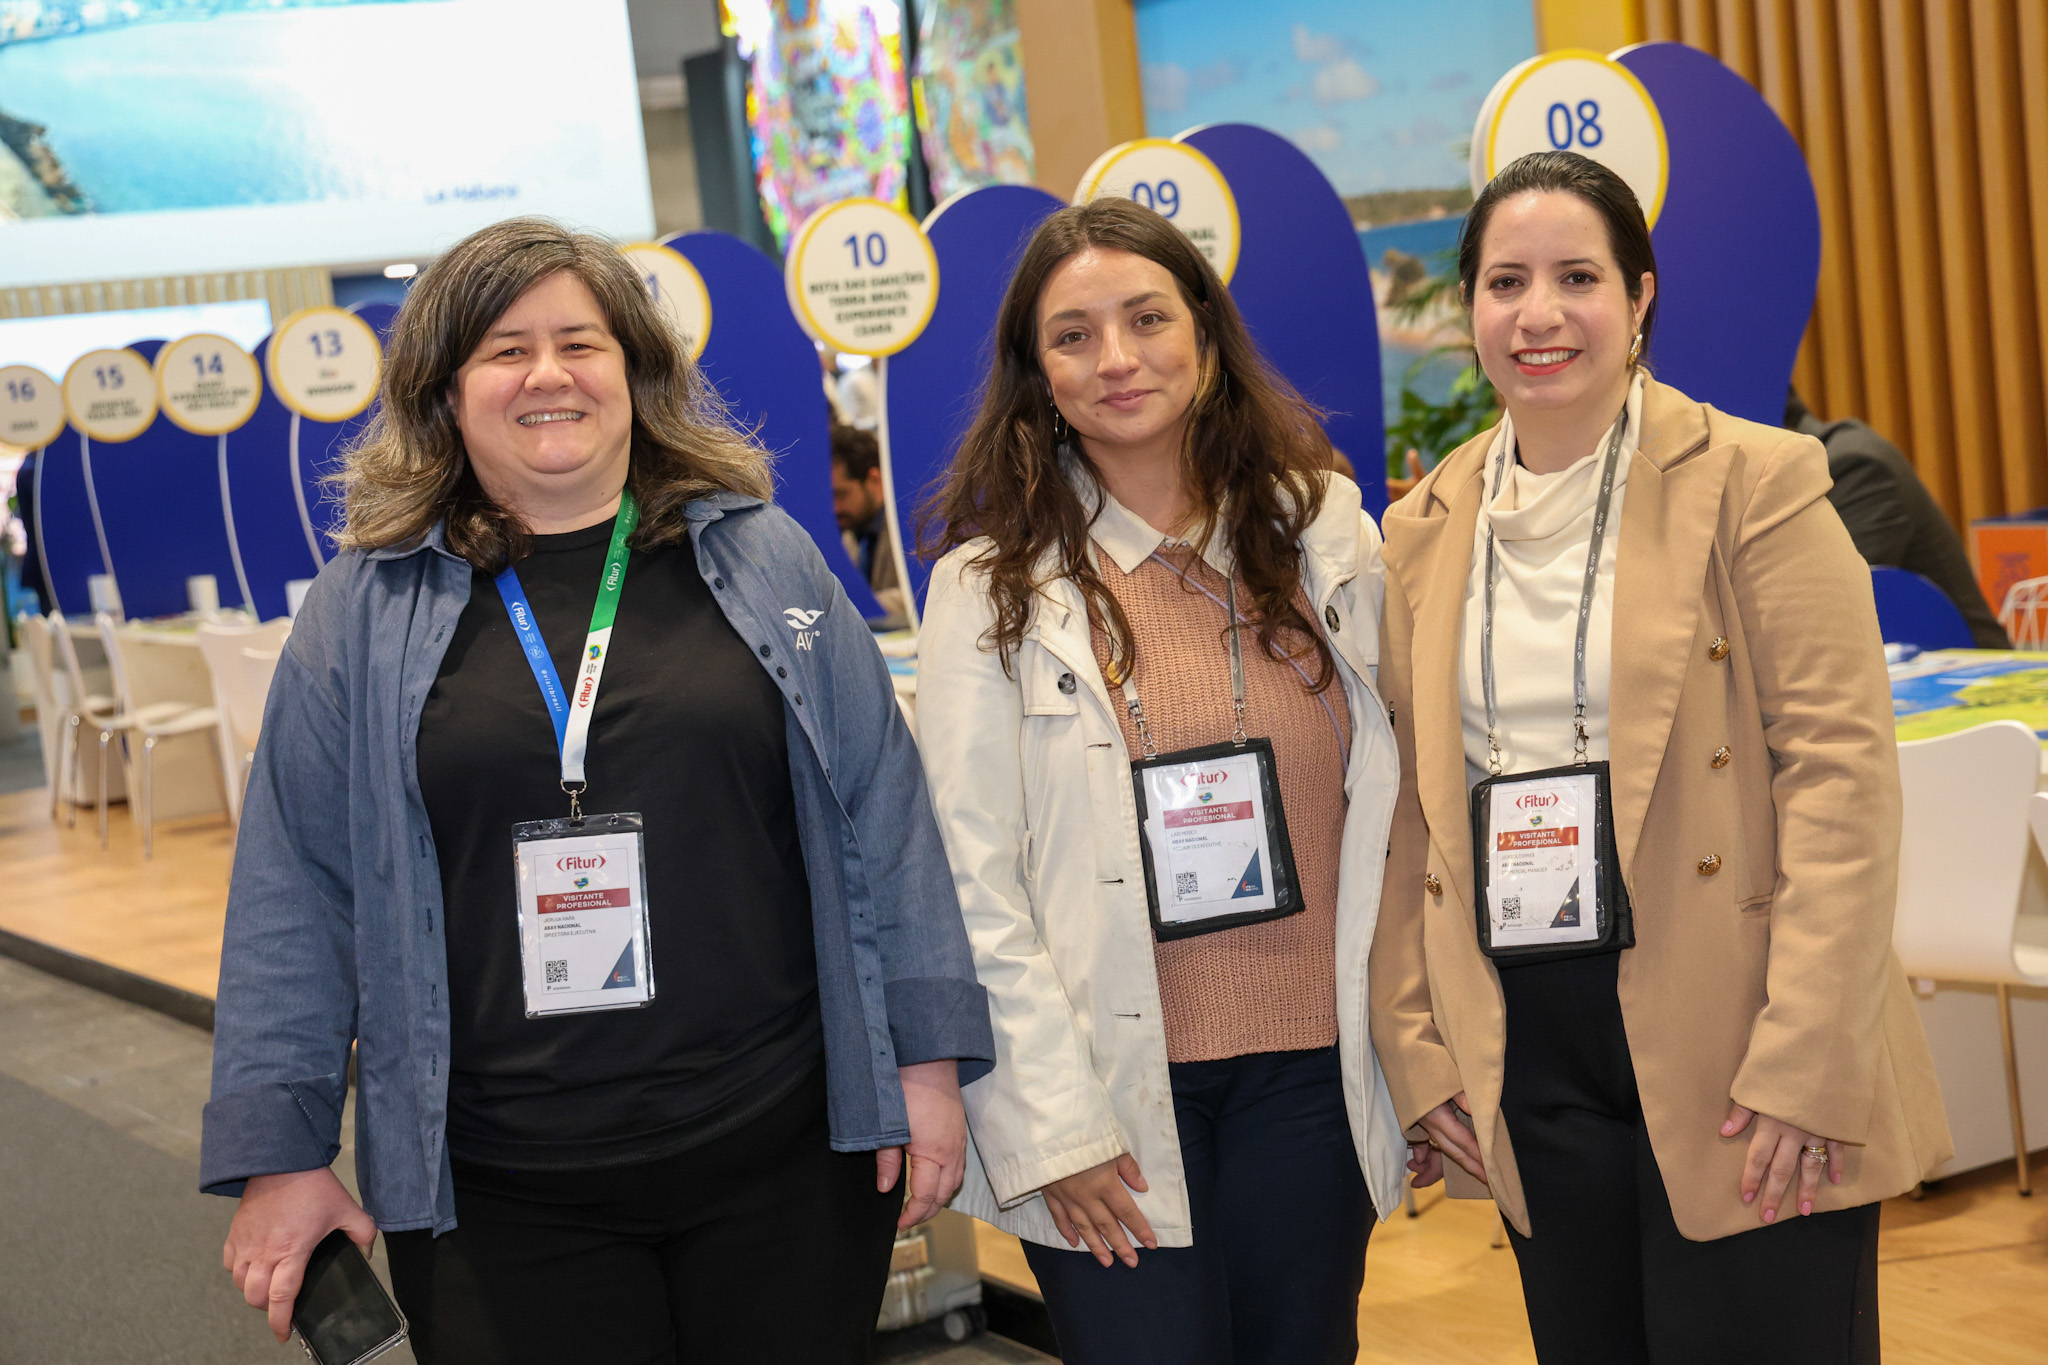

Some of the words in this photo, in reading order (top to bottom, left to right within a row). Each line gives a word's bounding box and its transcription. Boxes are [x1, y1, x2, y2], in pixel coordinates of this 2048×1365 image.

[1547, 100, 1603, 150] 08
[1132, 180, 1180, 218] 09
[843, 232, 887, 268] 10
[309, 329, 343, 358] 13
[193, 353, 224, 376] 14
[94, 365, 125, 390] 15
[6, 377, 36, 403] 16
[541, 669, 562, 712] @visitbrasil
[1183, 812, 1236, 824] PROFESIONAL
[1189, 806, 1228, 816] VISITANTE
[1513, 838, 1562, 847] PROFESIONAL
[1520, 830, 1556, 840] VISITANTE
[556, 899, 612, 910] PROFESIONAL
[563, 892, 604, 902] VISITANTE
